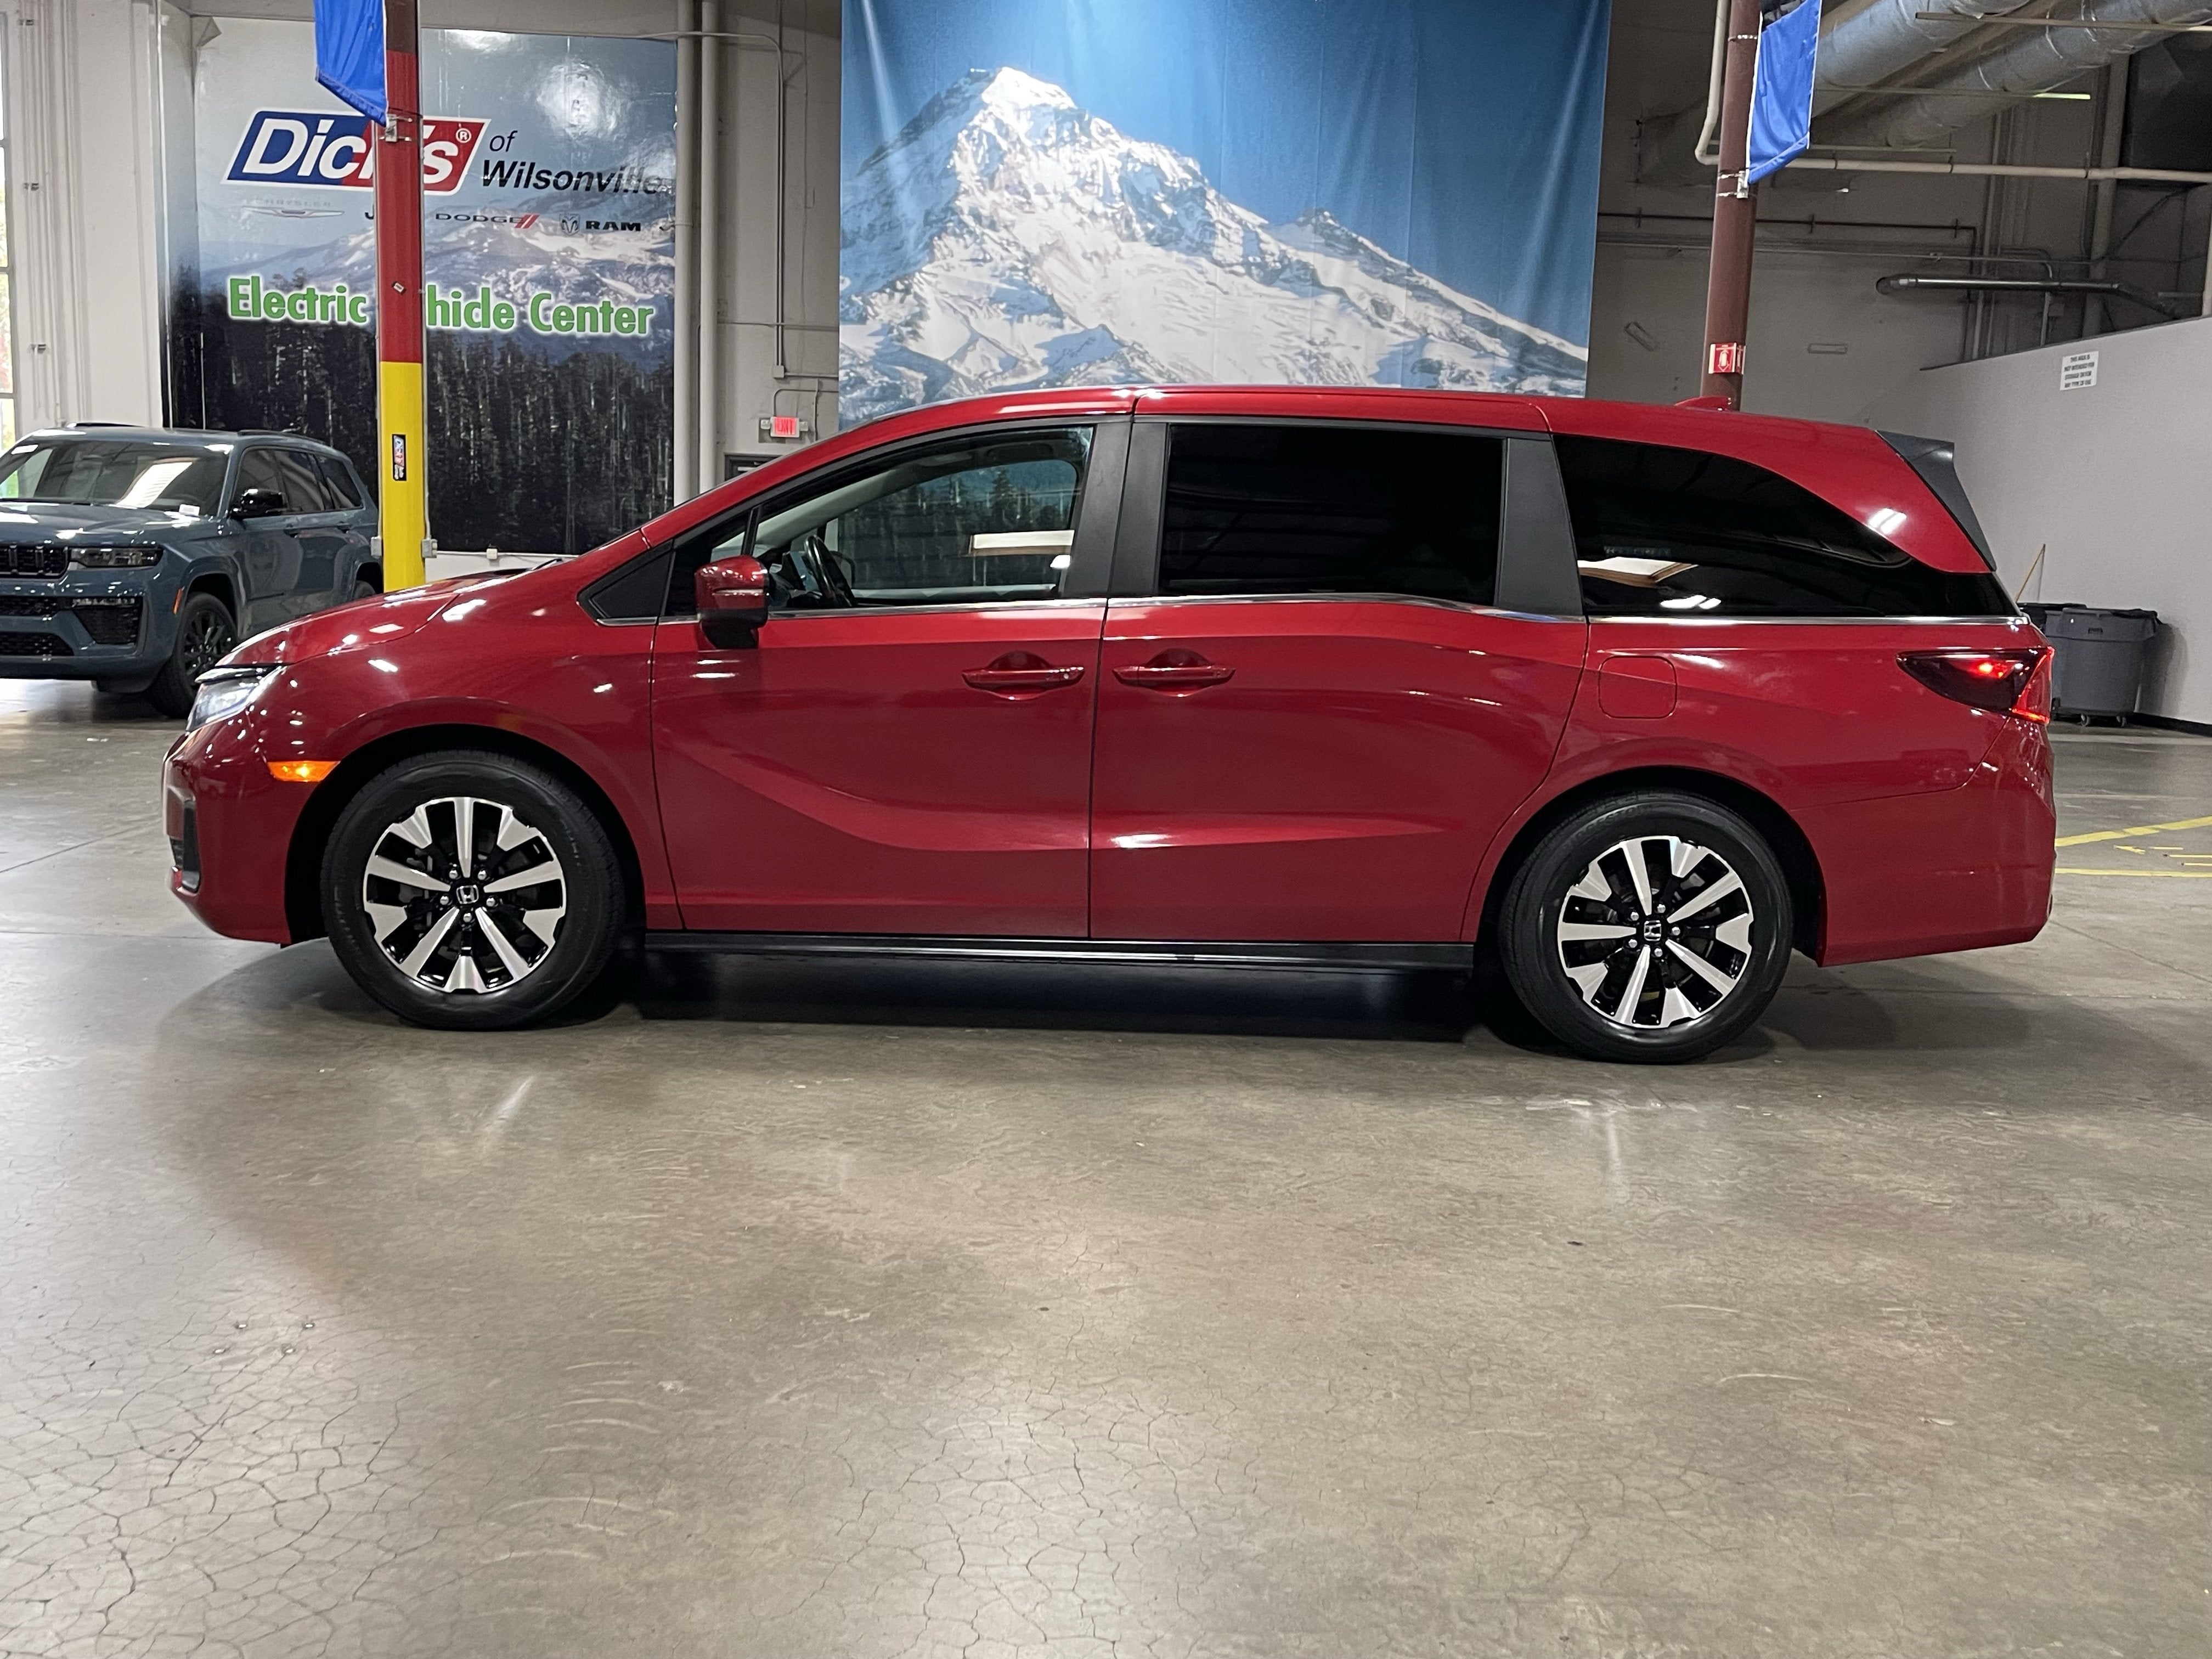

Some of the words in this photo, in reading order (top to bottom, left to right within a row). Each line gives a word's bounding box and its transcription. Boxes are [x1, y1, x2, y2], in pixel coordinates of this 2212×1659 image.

[242, 118, 459, 184] Dic's
[489, 131, 518, 152] of
[585, 220, 641, 232] RAM
[230, 275, 367, 323] Electric
[427, 284, 515, 329] hicle
[531, 293, 654, 334] Center
